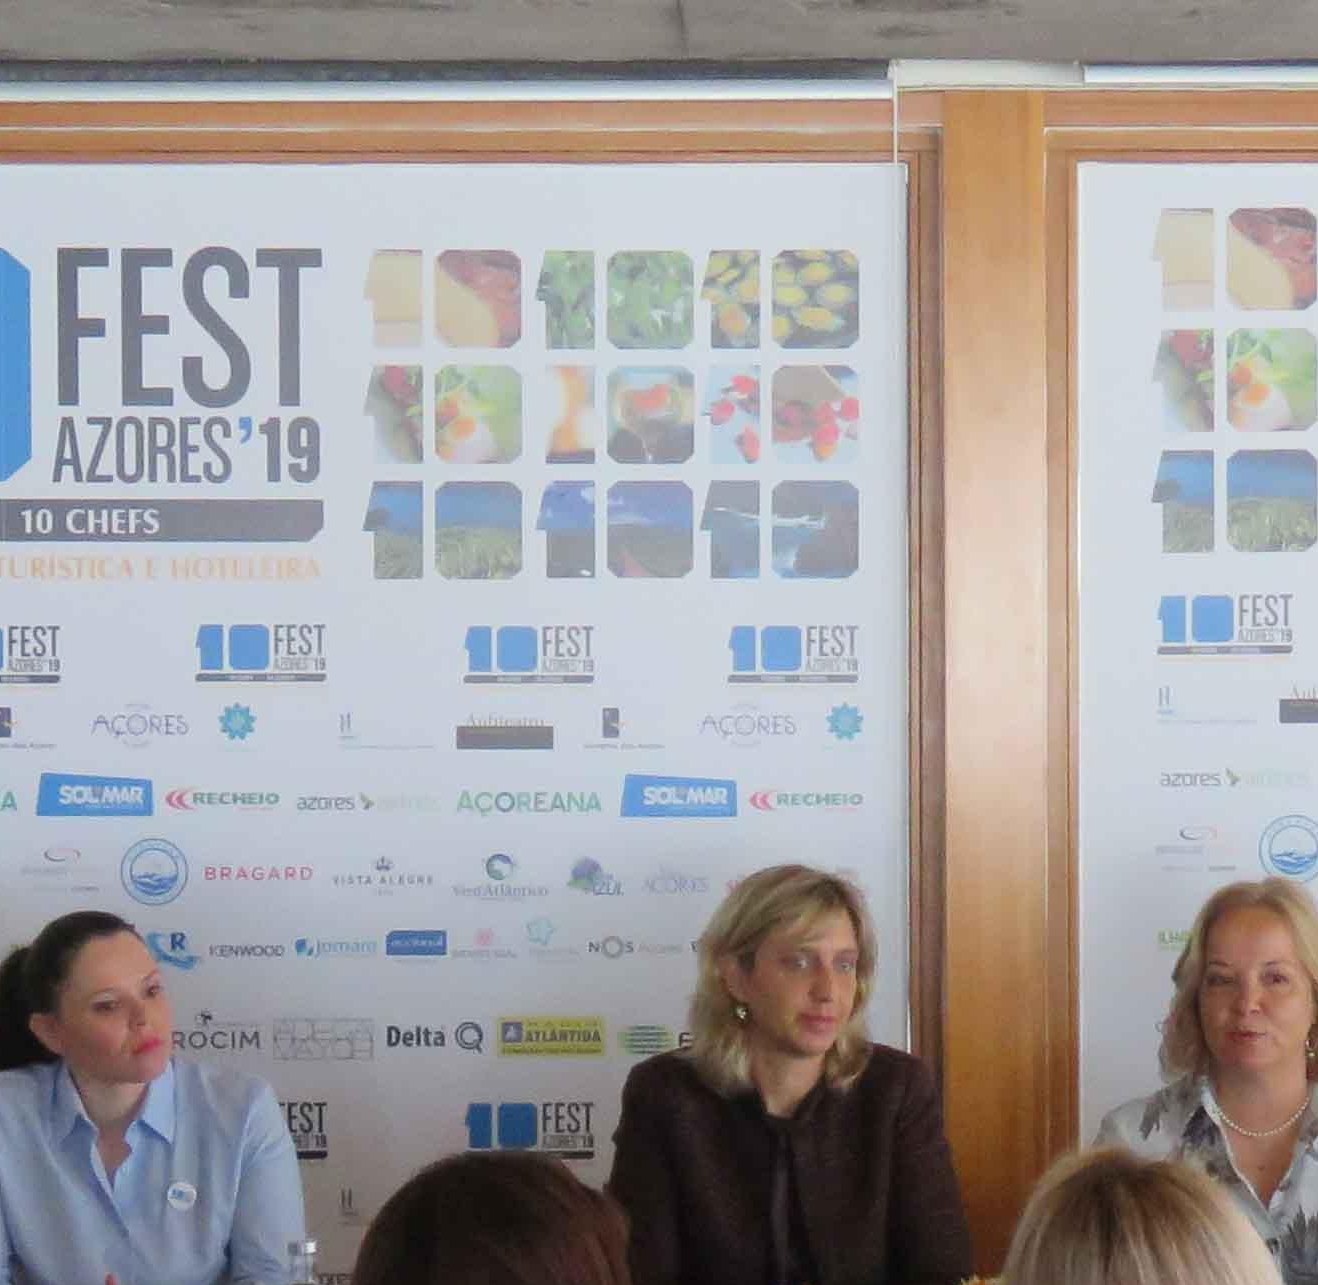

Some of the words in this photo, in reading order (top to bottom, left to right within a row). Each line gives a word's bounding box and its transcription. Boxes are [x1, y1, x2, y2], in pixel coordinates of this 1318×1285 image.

[57, 246, 322, 408] FEST
[22, 509, 53, 534] 10
[66, 509, 160, 535] CHEFS
[146, 556, 158, 579] E
[174, 556, 322, 581] HOTELEIRA
[1238, 594, 1293, 626] FEST
[8, 626, 60, 657] FEST
[274, 624, 326, 656] FEST
[542, 626, 594, 657] FEST
[806, 626, 859, 657] FEST
[91, 712, 189, 738] AÇORES
[697, 712, 797, 738] AÇORES
[1160, 771, 1221, 787] azores
[192, 792, 279, 805] RECHEIO
[296, 794, 355, 811] azores
[457, 789, 602, 816] AÇOREANA
[776, 792, 864, 806] RECHEIO
[204, 865, 313, 881] BRAGARD
[209, 944, 284, 958] KENWOOD
[171, 1031, 260, 1049] ROCIM
[387, 1025, 446, 1047] Delta
[542, 1102, 594, 1133] FEST
